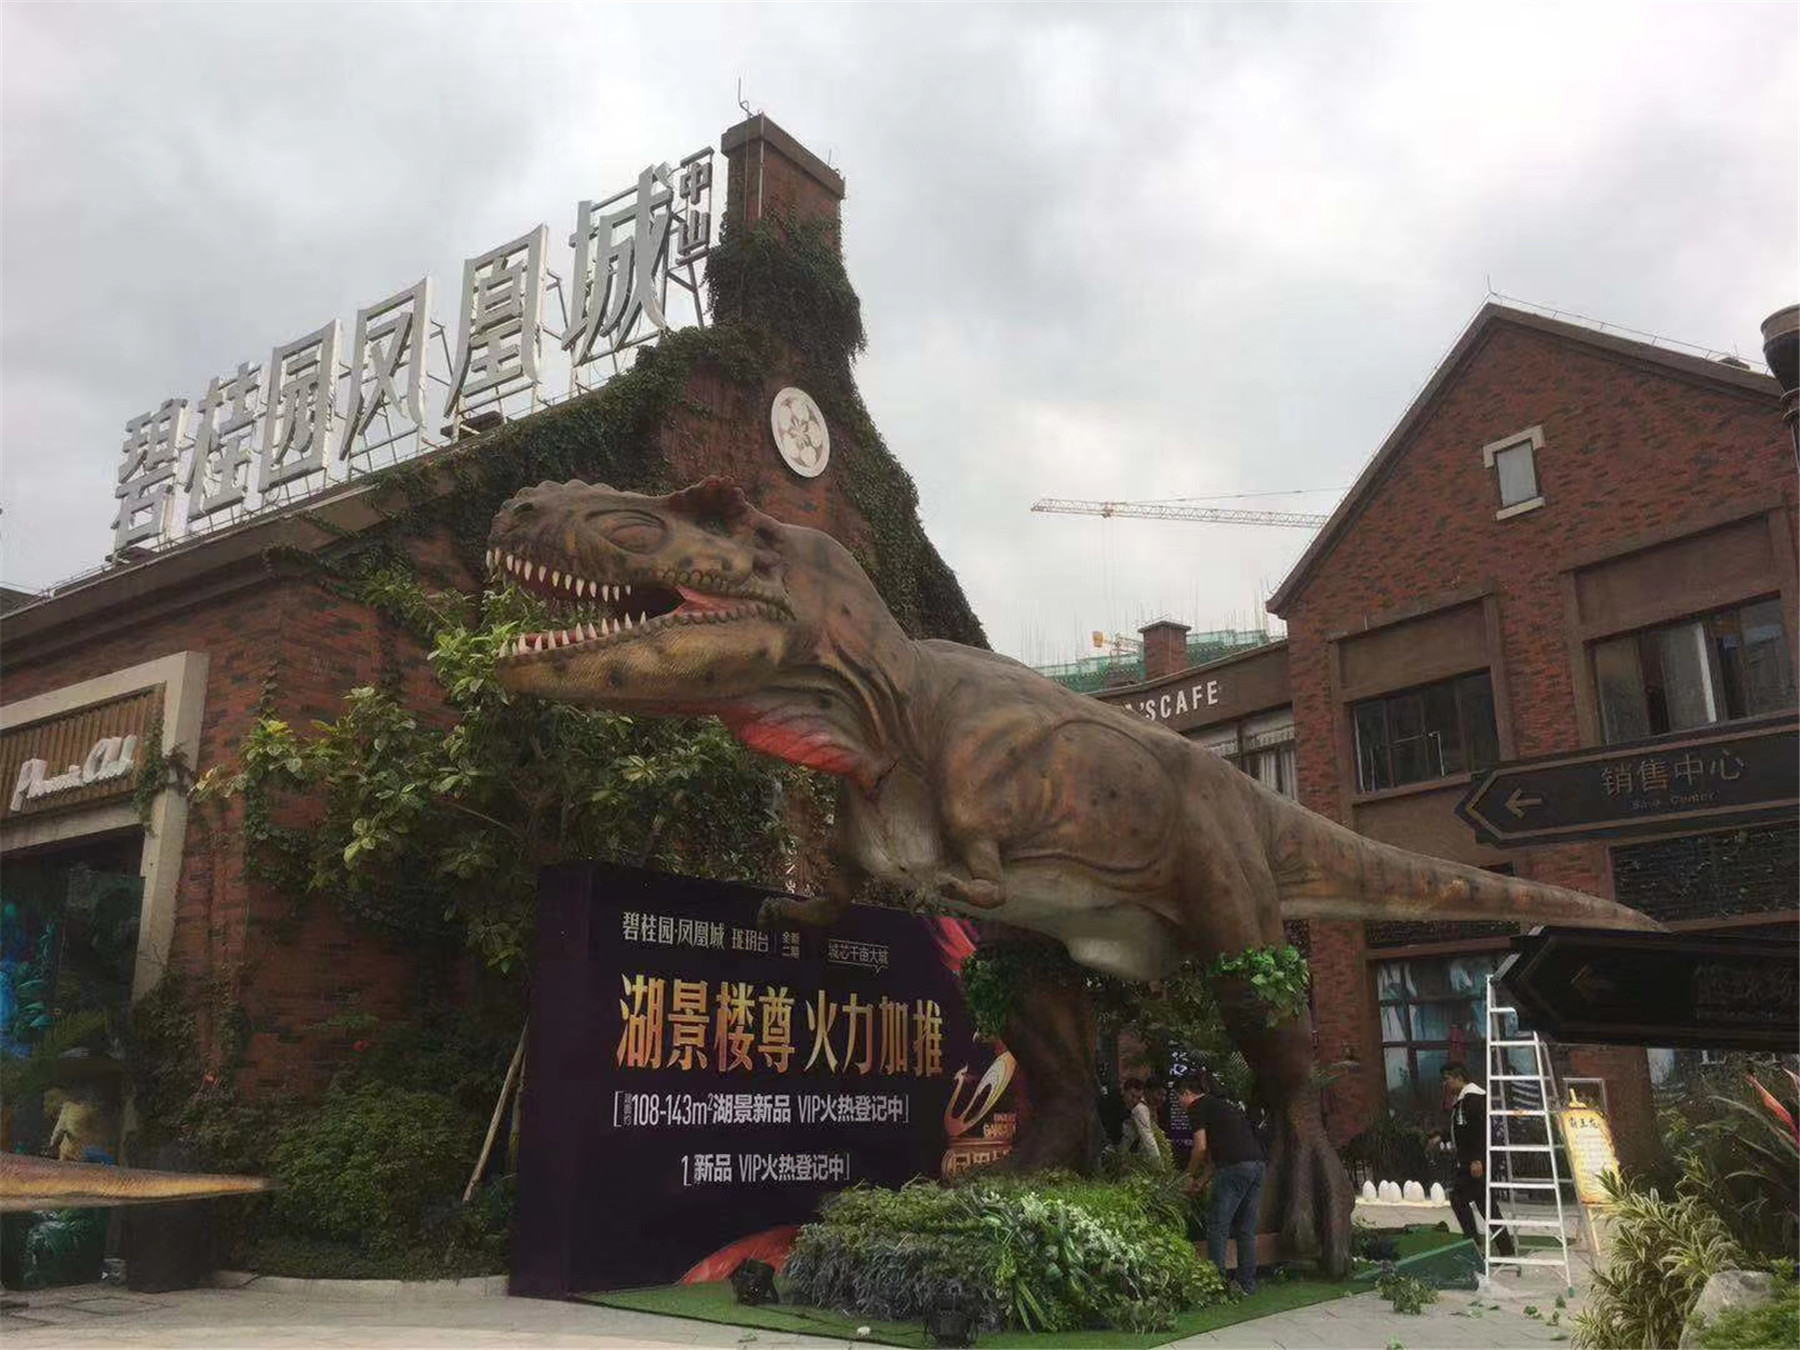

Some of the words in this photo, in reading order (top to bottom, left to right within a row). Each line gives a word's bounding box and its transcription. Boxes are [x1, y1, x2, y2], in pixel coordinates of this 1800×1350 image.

[678, 161, 712, 256] 中山
[111, 161, 668, 552] 碧桂园凤凰城
[1601, 749, 1746, 795] 销售中心
